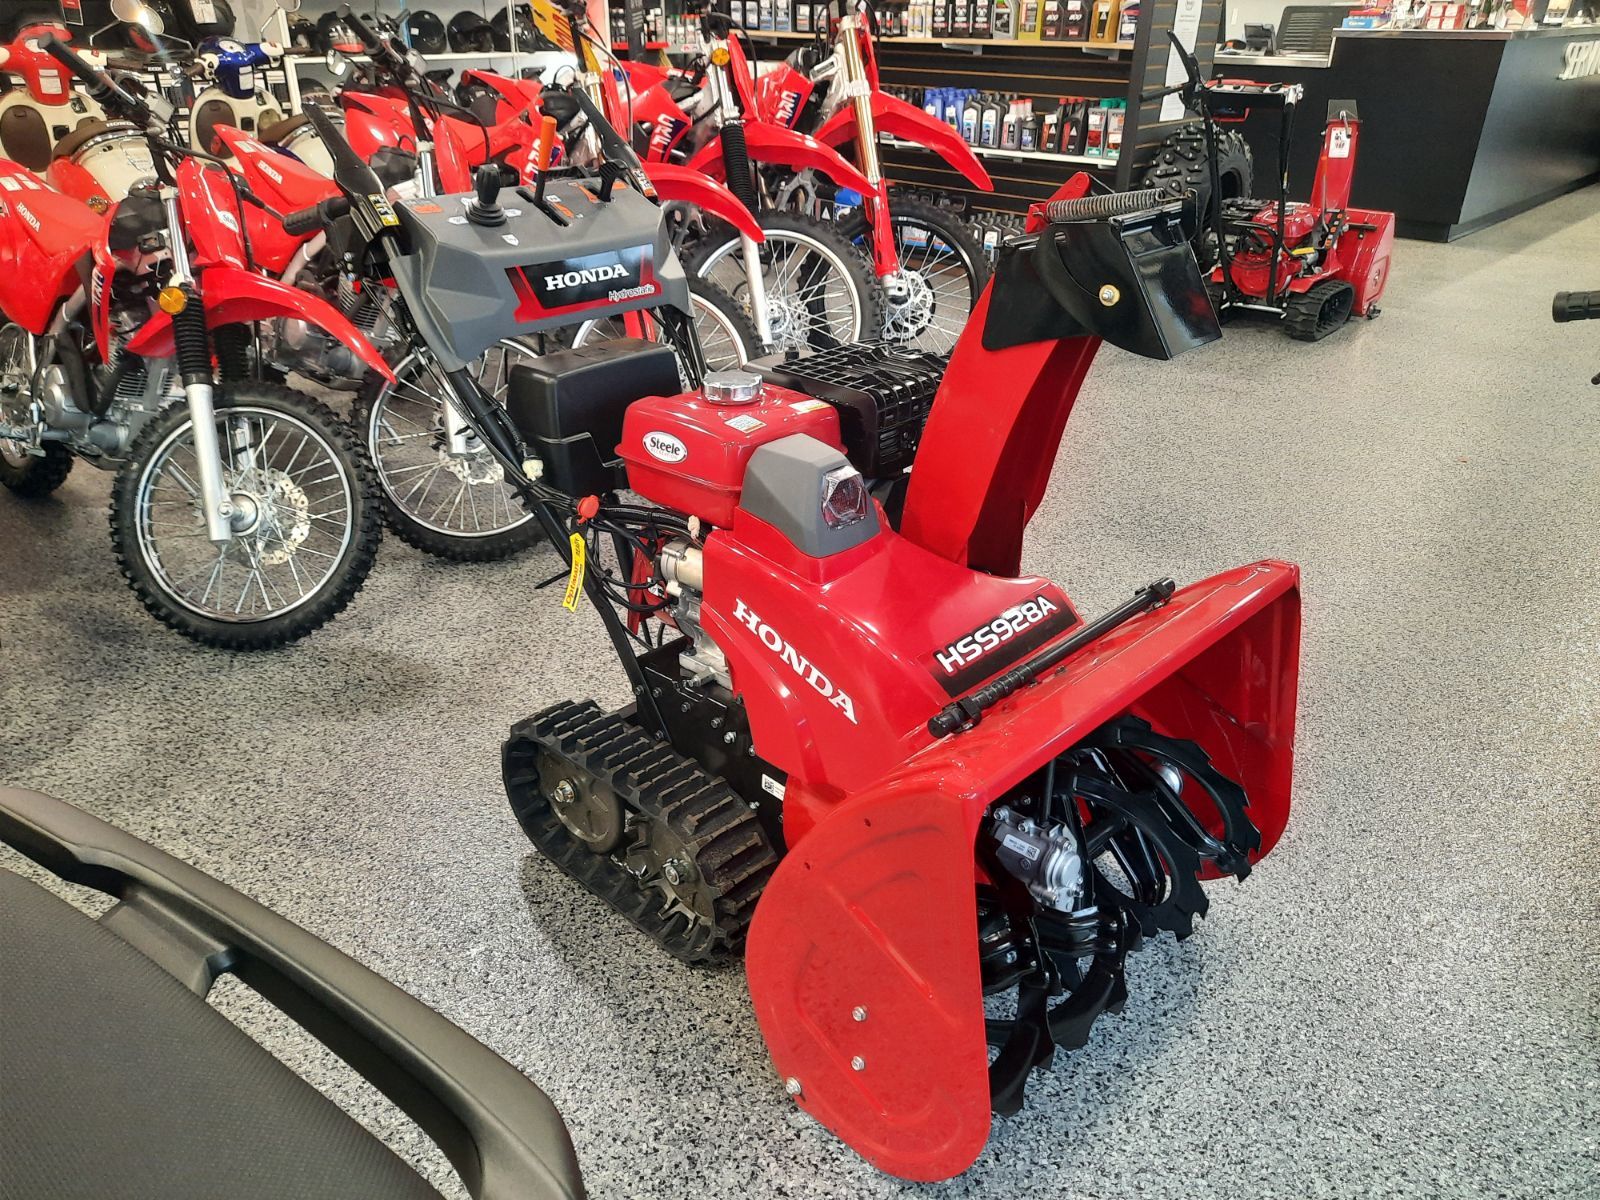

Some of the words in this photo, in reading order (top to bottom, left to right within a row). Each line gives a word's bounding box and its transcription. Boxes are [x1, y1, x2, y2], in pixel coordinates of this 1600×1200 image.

[16, 202, 41, 232] HONDA
[544, 264, 630, 290] HONDA
[608, 284, 655, 302] Hydrostatic
[650, 436, 680, 455] Steele
[936, 596, 1057, 673] HSS928A
[732, 598, 858, 725] HONDA
